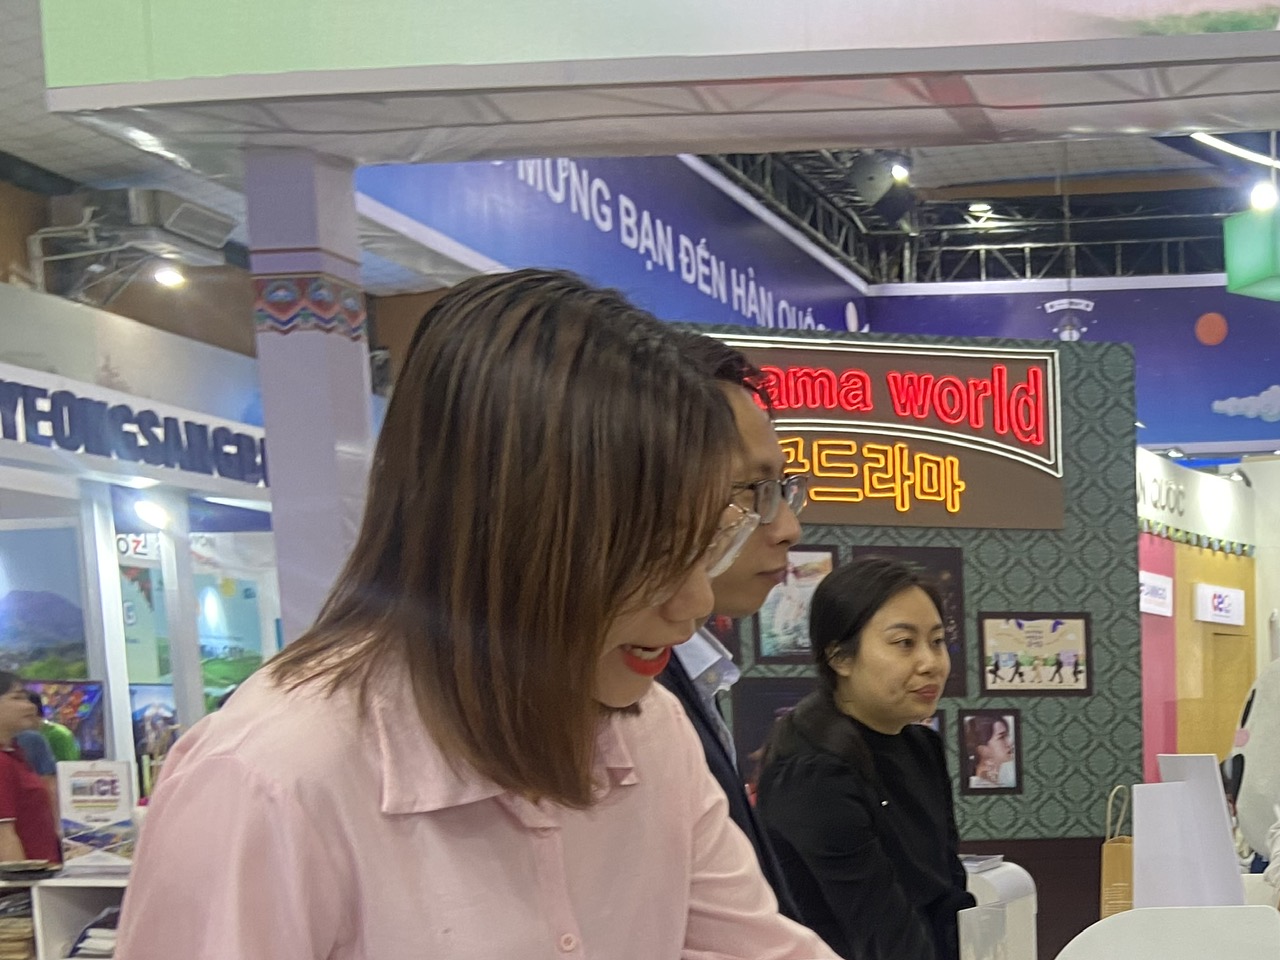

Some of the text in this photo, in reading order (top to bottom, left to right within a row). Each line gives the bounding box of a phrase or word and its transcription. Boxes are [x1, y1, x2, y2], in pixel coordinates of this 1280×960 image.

[619, 194, 674, 272] BẠN
[679, 237, 727, 304] ĐẾN
[731, 266, 773, 329] HÀN
[746, 364, 1045, 445] ama world
